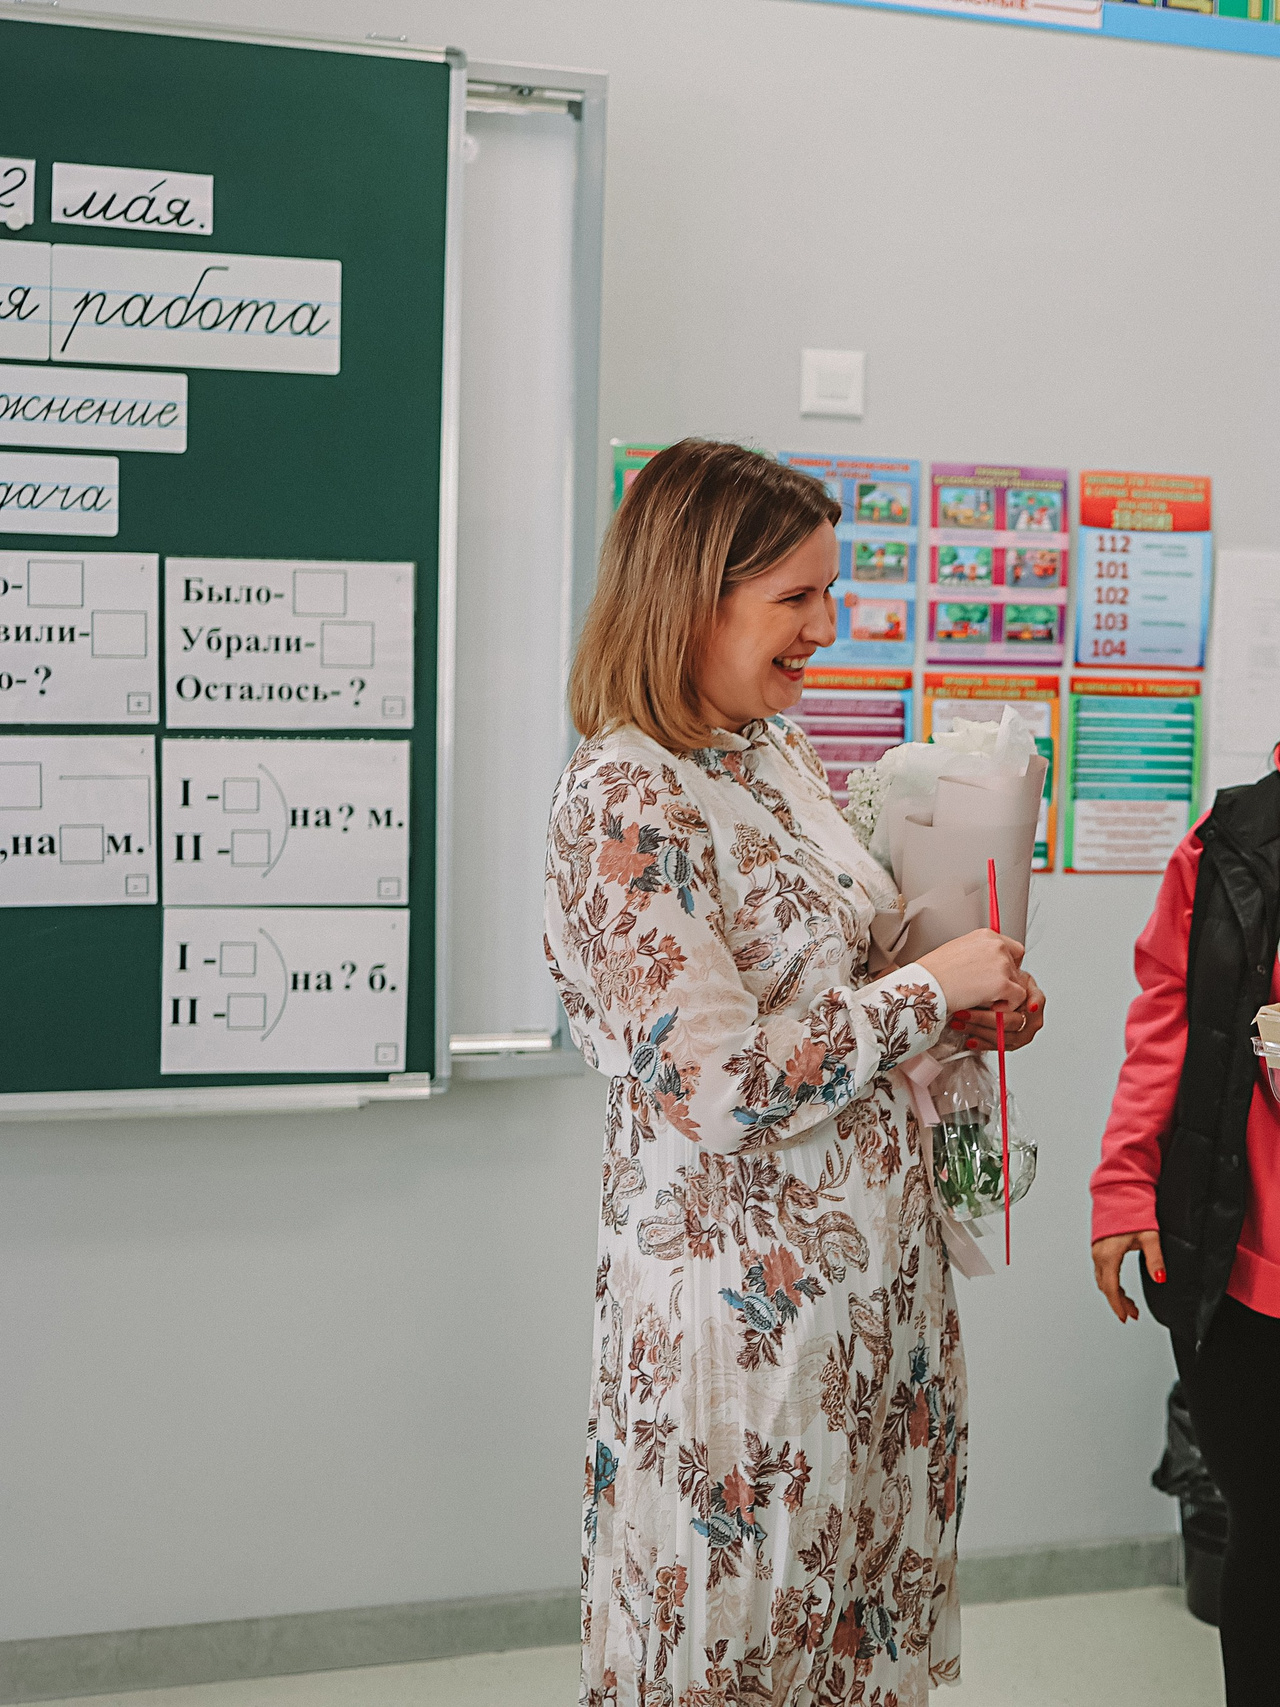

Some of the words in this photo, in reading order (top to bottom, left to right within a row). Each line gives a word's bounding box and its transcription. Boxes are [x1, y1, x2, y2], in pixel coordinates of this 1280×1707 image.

[60, 266, 330, 353] работа
[1098, 536, 1130, 553] 112
[1097, 561, 1128, 579] 101
[183, 578, 284, 603] Было-
[1096, 587, 1128, 605] 102
[1095, 613, 1128, 631] 103
[182, 627, 315, 659] Убрали-
[1093, 640, 1126, 657] 104
